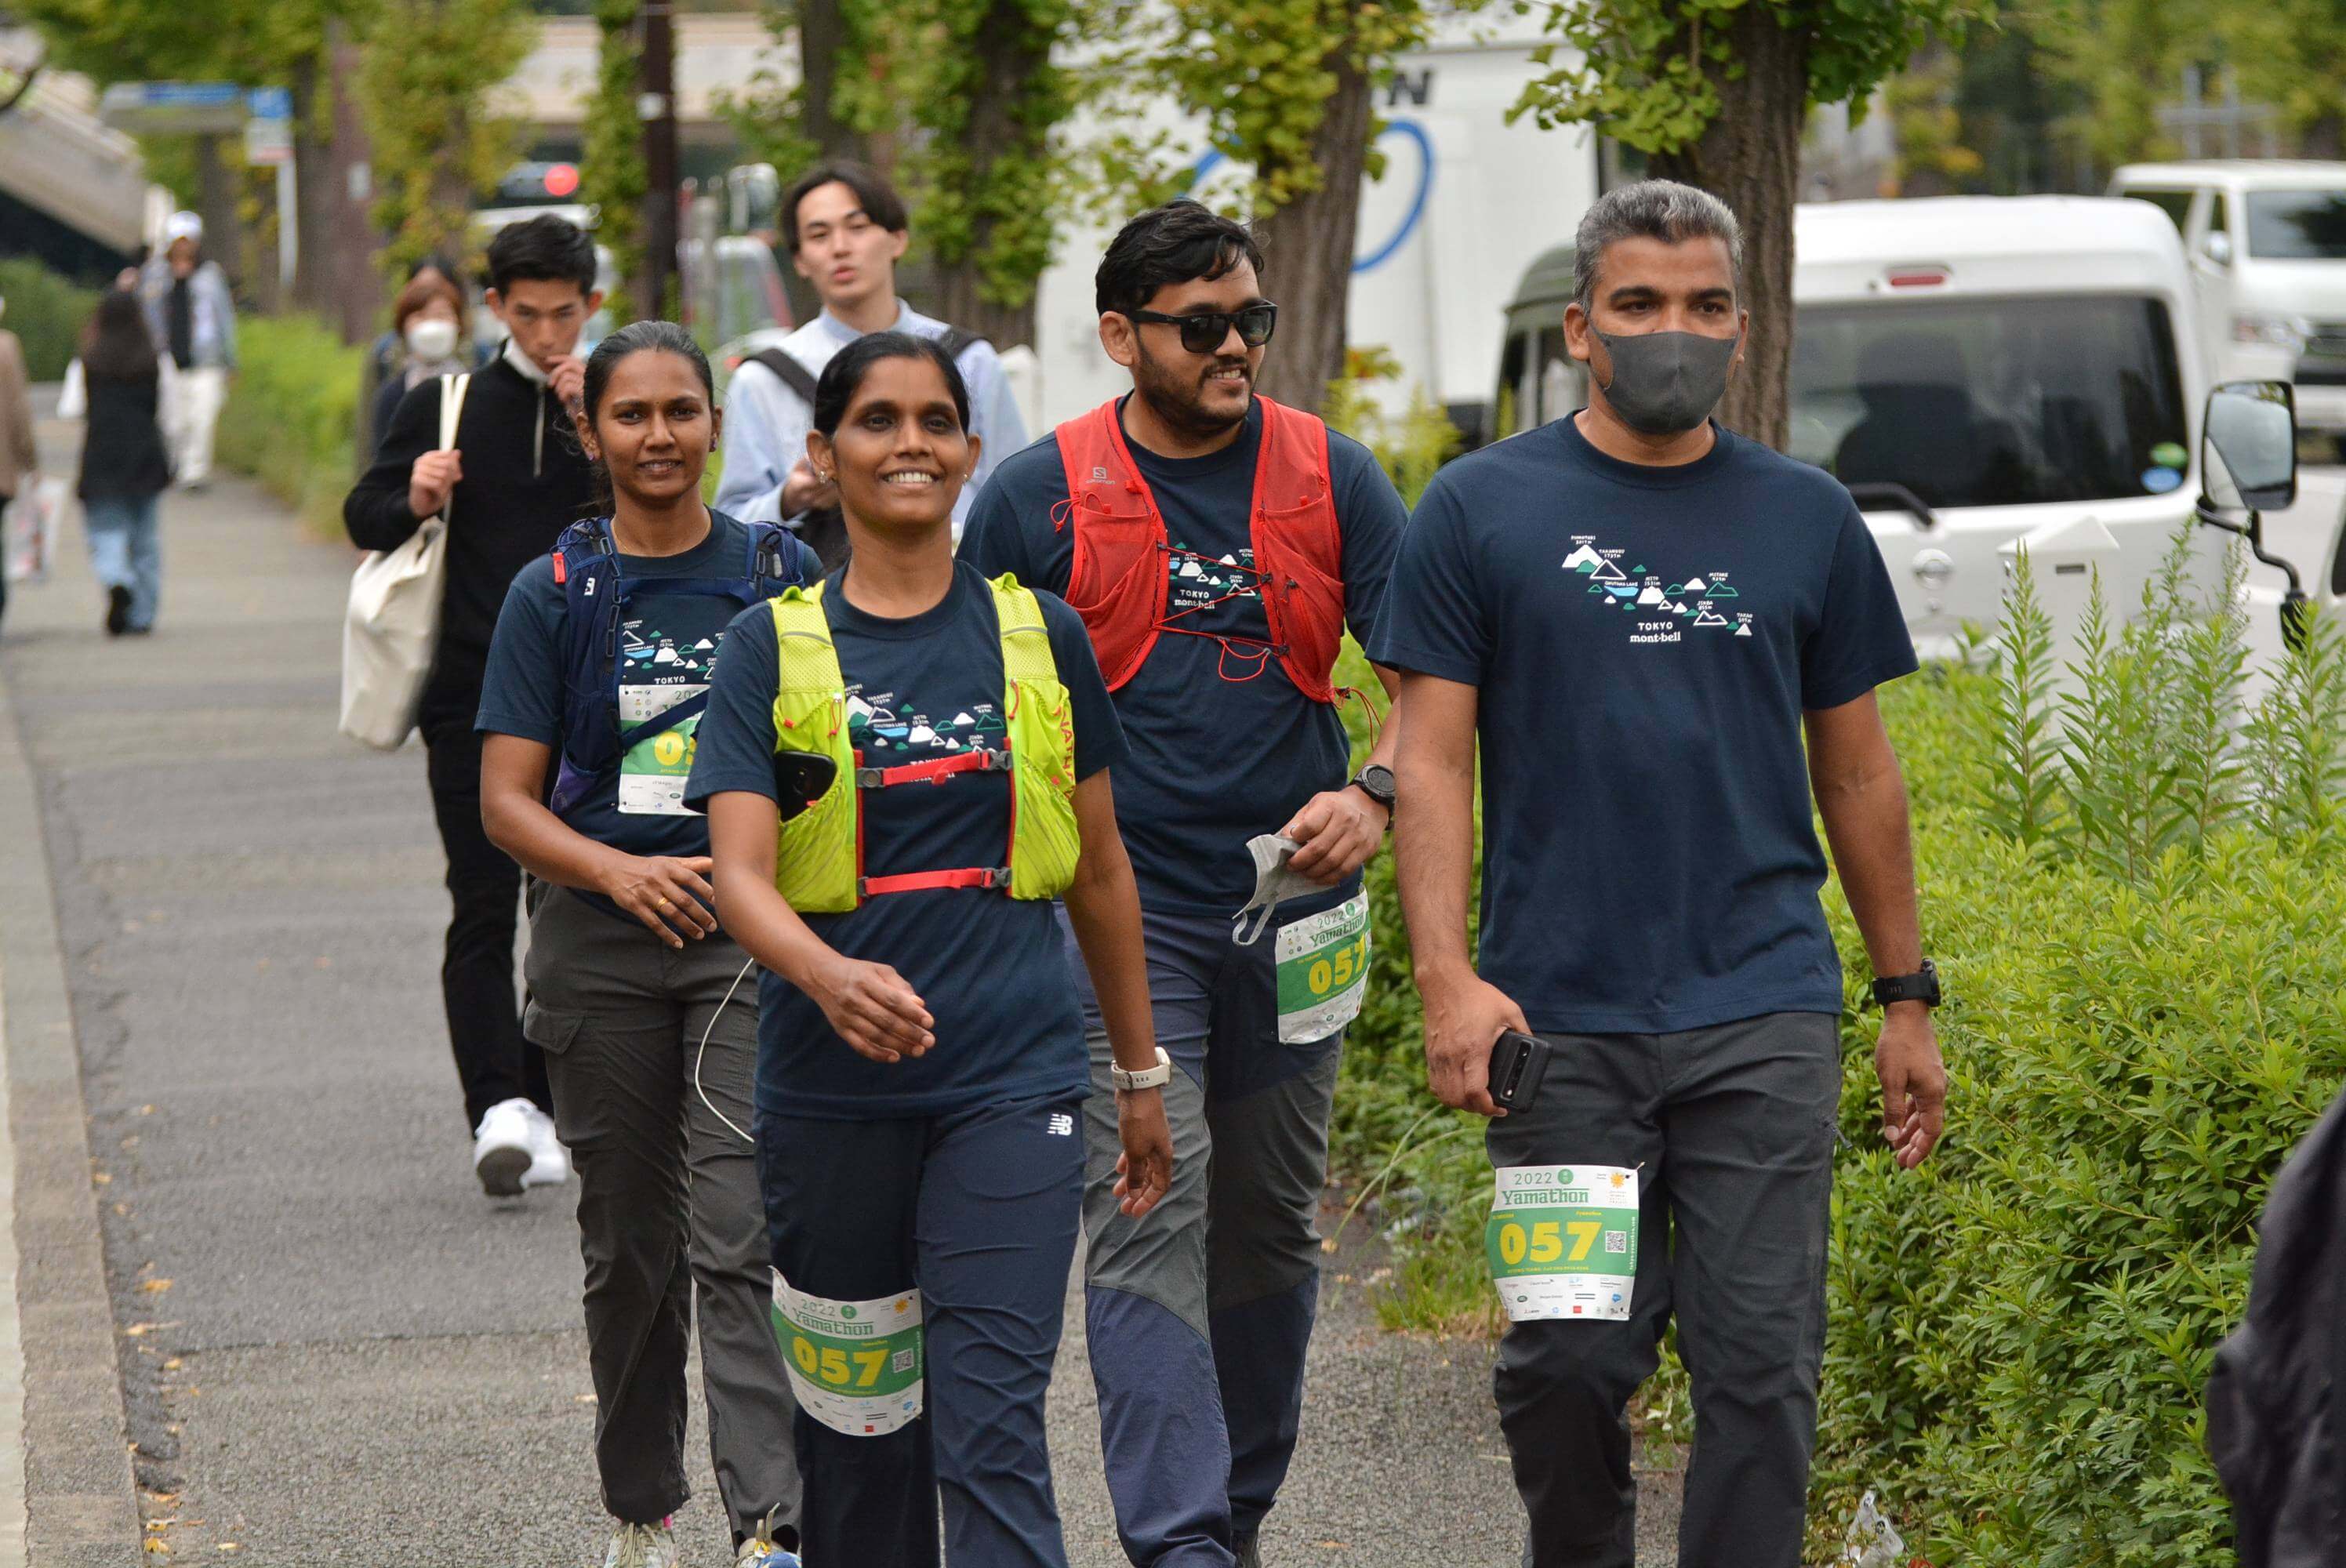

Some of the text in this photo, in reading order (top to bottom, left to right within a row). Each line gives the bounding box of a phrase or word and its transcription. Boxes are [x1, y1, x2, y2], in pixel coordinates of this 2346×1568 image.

[1180, 590, 1209, 598] TOKYO
[1637, 622, 1673, 630] TOKYO
[1317, 911, 1345, 929] 2022
[1309, 915, 1364, 947] Yamathon
[1309, 933, 1365, 994] 057
[1514, 1172, 1552, 1185] 2022
[1502, 1189, 1590, 1205] Yamathon
[1500, 1221, 1603, 1265] 057
[801, 1298, 837, 1317] 2022
[792, 1308, 875, 1336] Yamathon
[793, 1335, 890, 1387] 057
